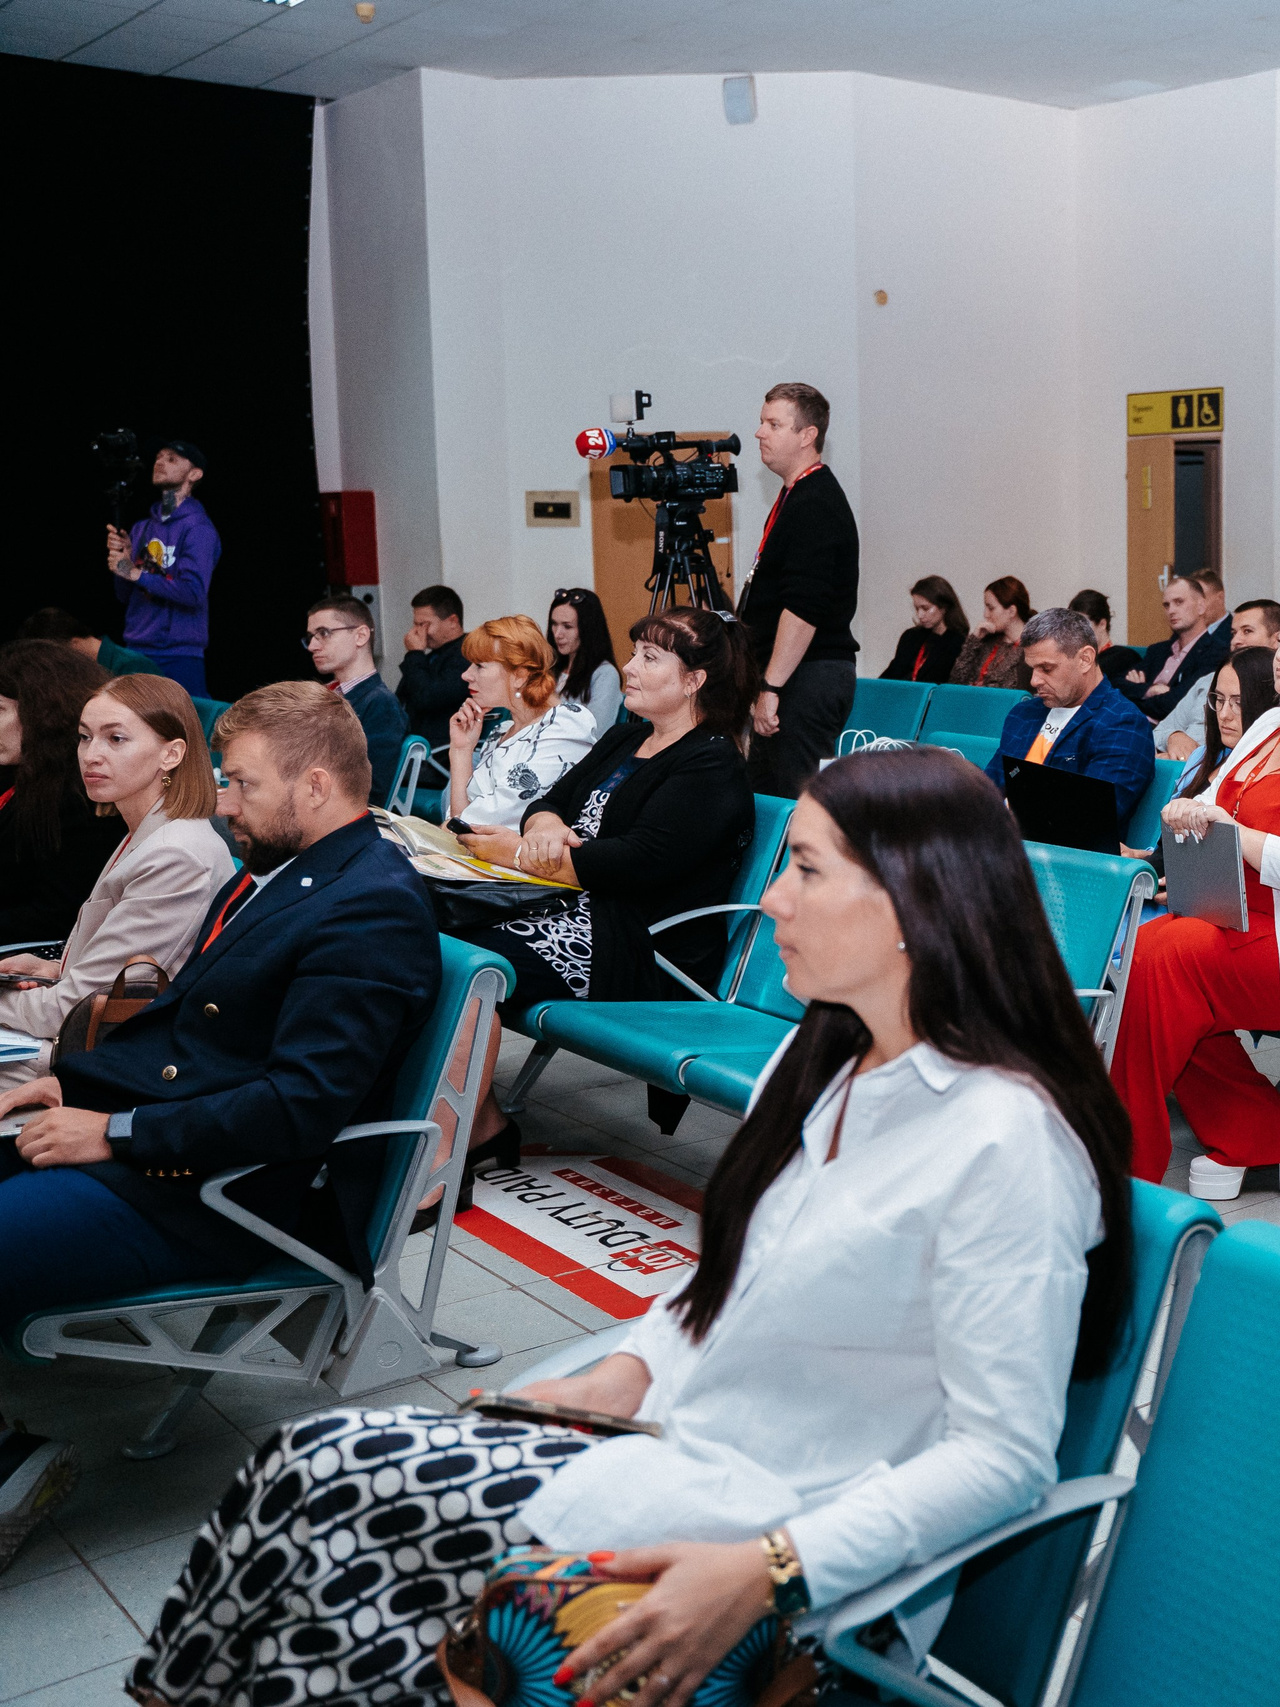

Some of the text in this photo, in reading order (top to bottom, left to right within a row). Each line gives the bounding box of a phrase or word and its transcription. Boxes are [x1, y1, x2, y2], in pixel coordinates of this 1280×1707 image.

[585, 430, 603, 446] 24
[476, 1168, 651, 1248] DUTY PAID
